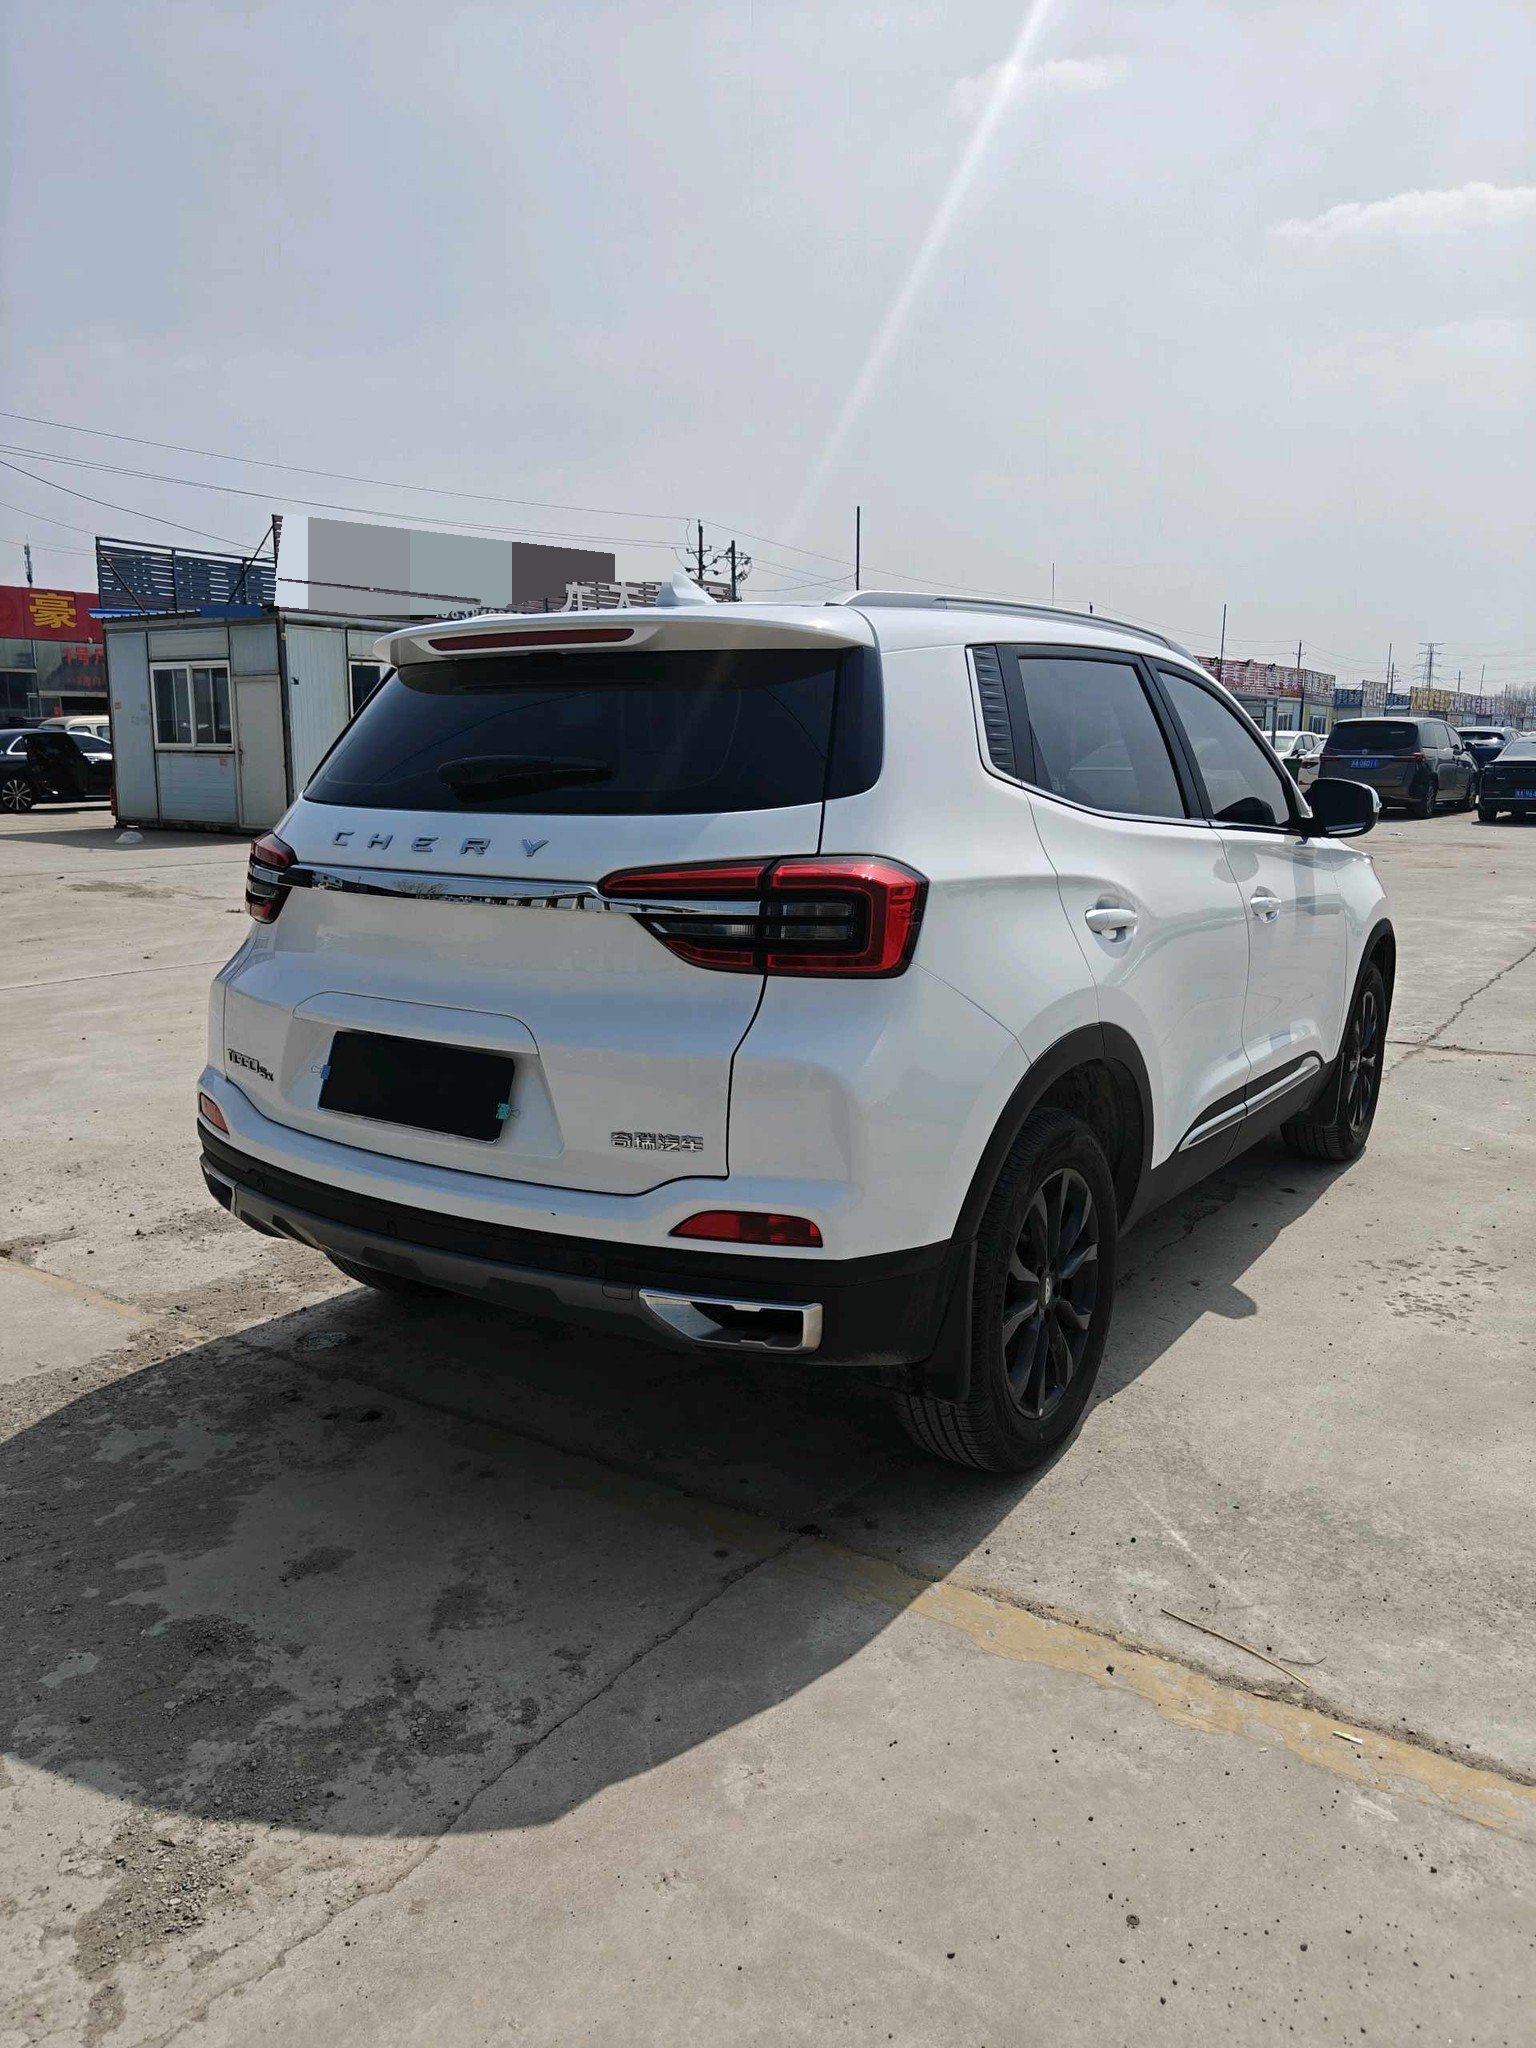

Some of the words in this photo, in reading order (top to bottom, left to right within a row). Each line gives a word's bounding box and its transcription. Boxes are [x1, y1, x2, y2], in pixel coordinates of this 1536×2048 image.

[29, 593, 77, 629] 豪
[332, 832, 550, 857] CHERY
[611, 1131, 704, 1153] 奇瑞汽车
